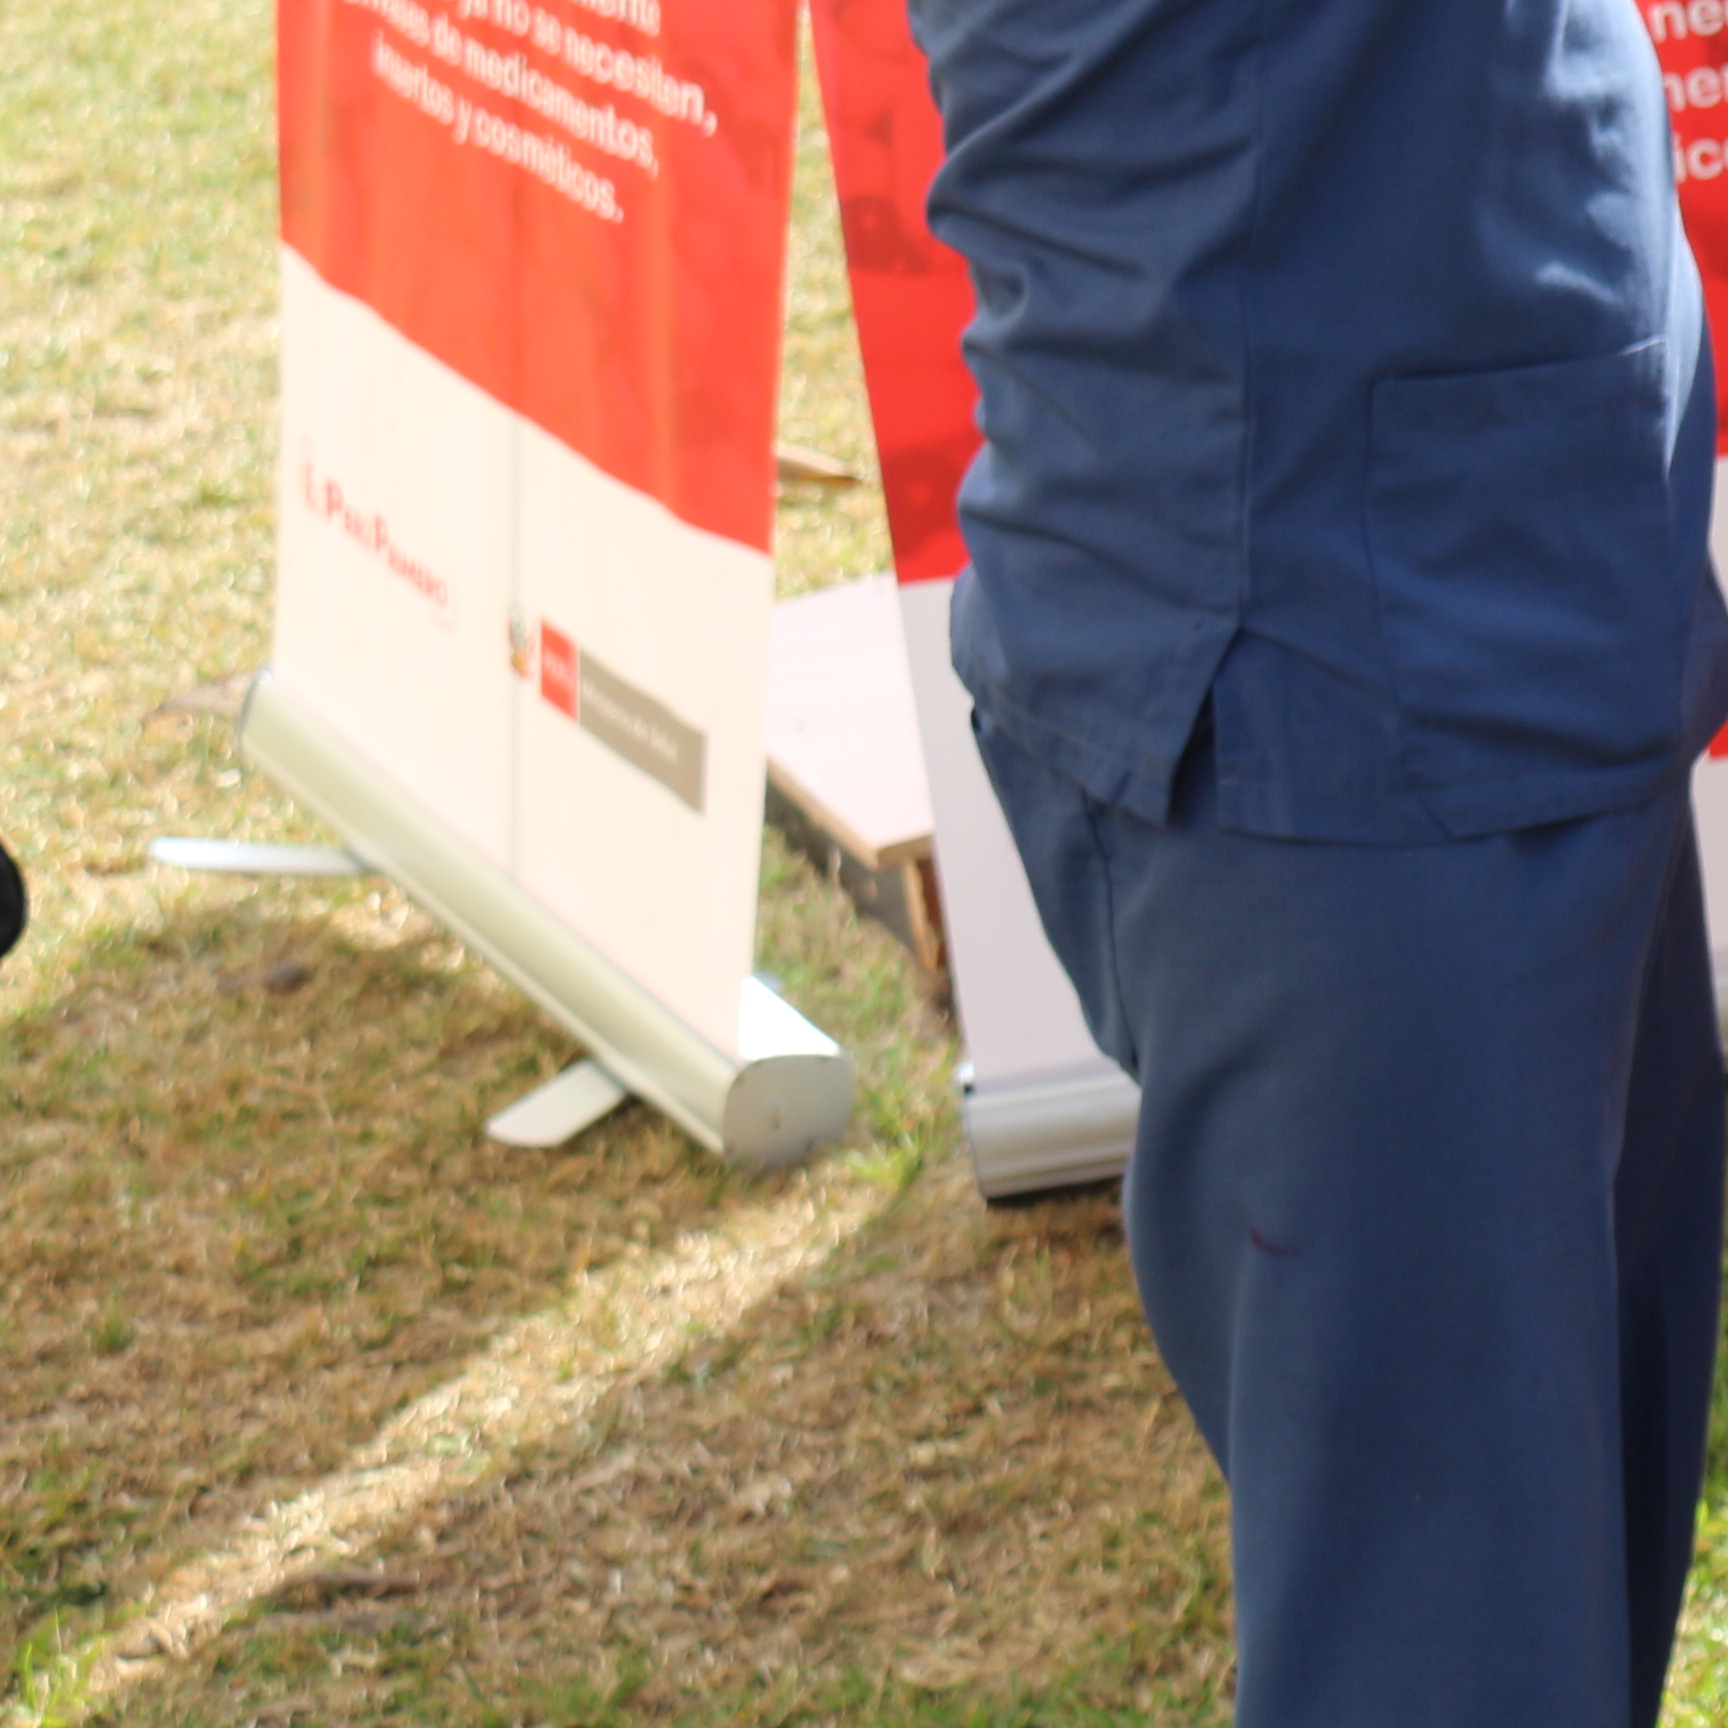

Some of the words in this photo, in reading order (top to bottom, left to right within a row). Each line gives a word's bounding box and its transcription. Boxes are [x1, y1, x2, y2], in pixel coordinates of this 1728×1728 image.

[432, 13, 462, 68] de
[533, 6, 563, 51] se
[453, 94, 474, 145] y
